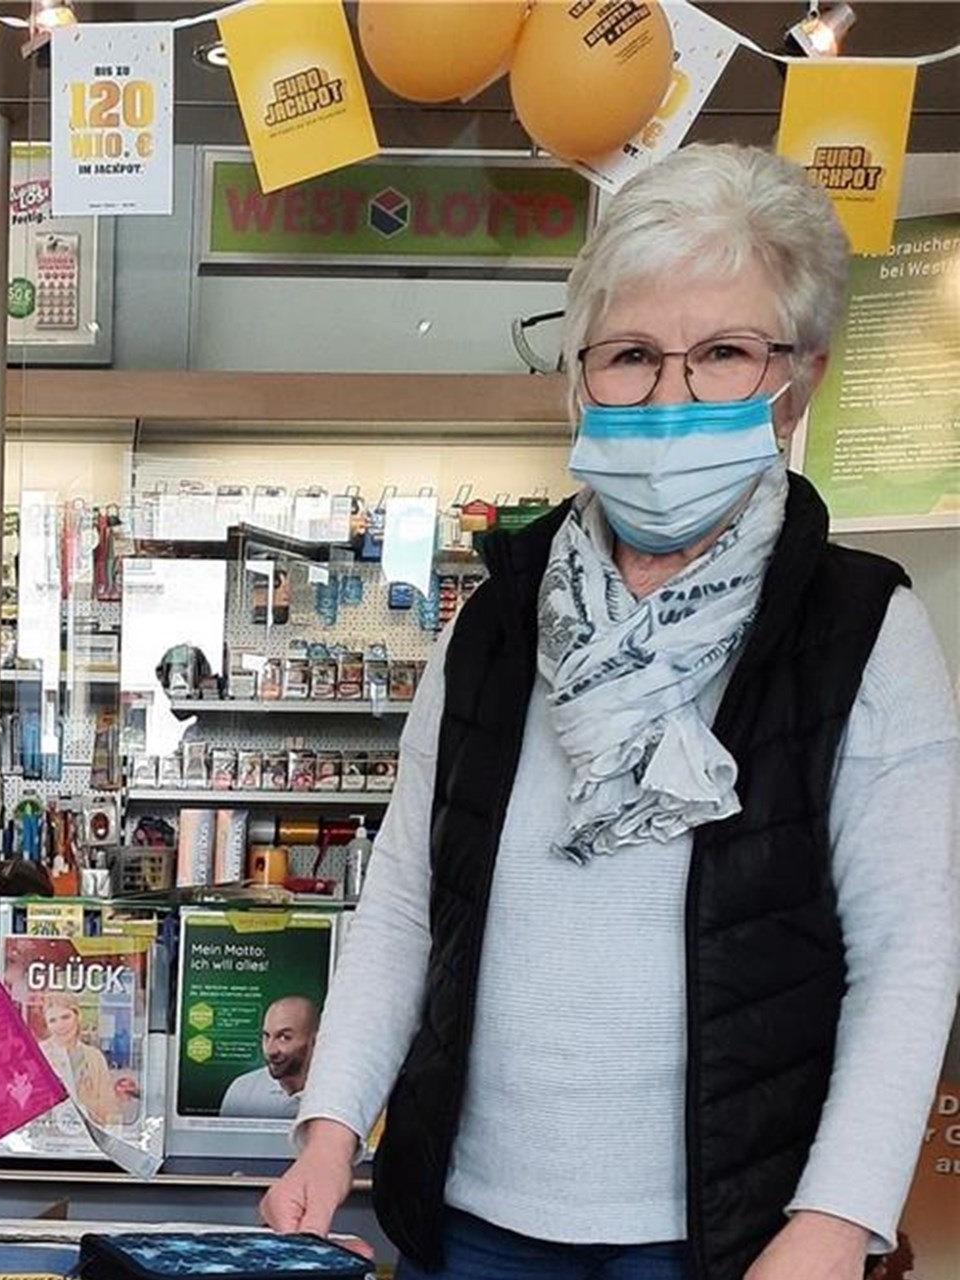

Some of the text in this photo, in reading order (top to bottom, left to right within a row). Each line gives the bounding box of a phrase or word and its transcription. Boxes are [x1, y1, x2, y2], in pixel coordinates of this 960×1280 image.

[94, 66, 130, 76] BIS ZU
[273, 67, 330, 102] EURO
[70, 80, 154, 128] 120
[265, 78, 345, 126] JACKPOT
[70, 132, 154, 159] MIO. €
[813, 146, 871, 168] EURO
[78, 165, 92, 174] IM
[804, 166, 883, 190] ACKPOT
[225, 187, 577, 240] WEST LOTTO
[191, 944, 266, 957] Mein Motto:
[28, 956, 126, 993] GLÜCK
